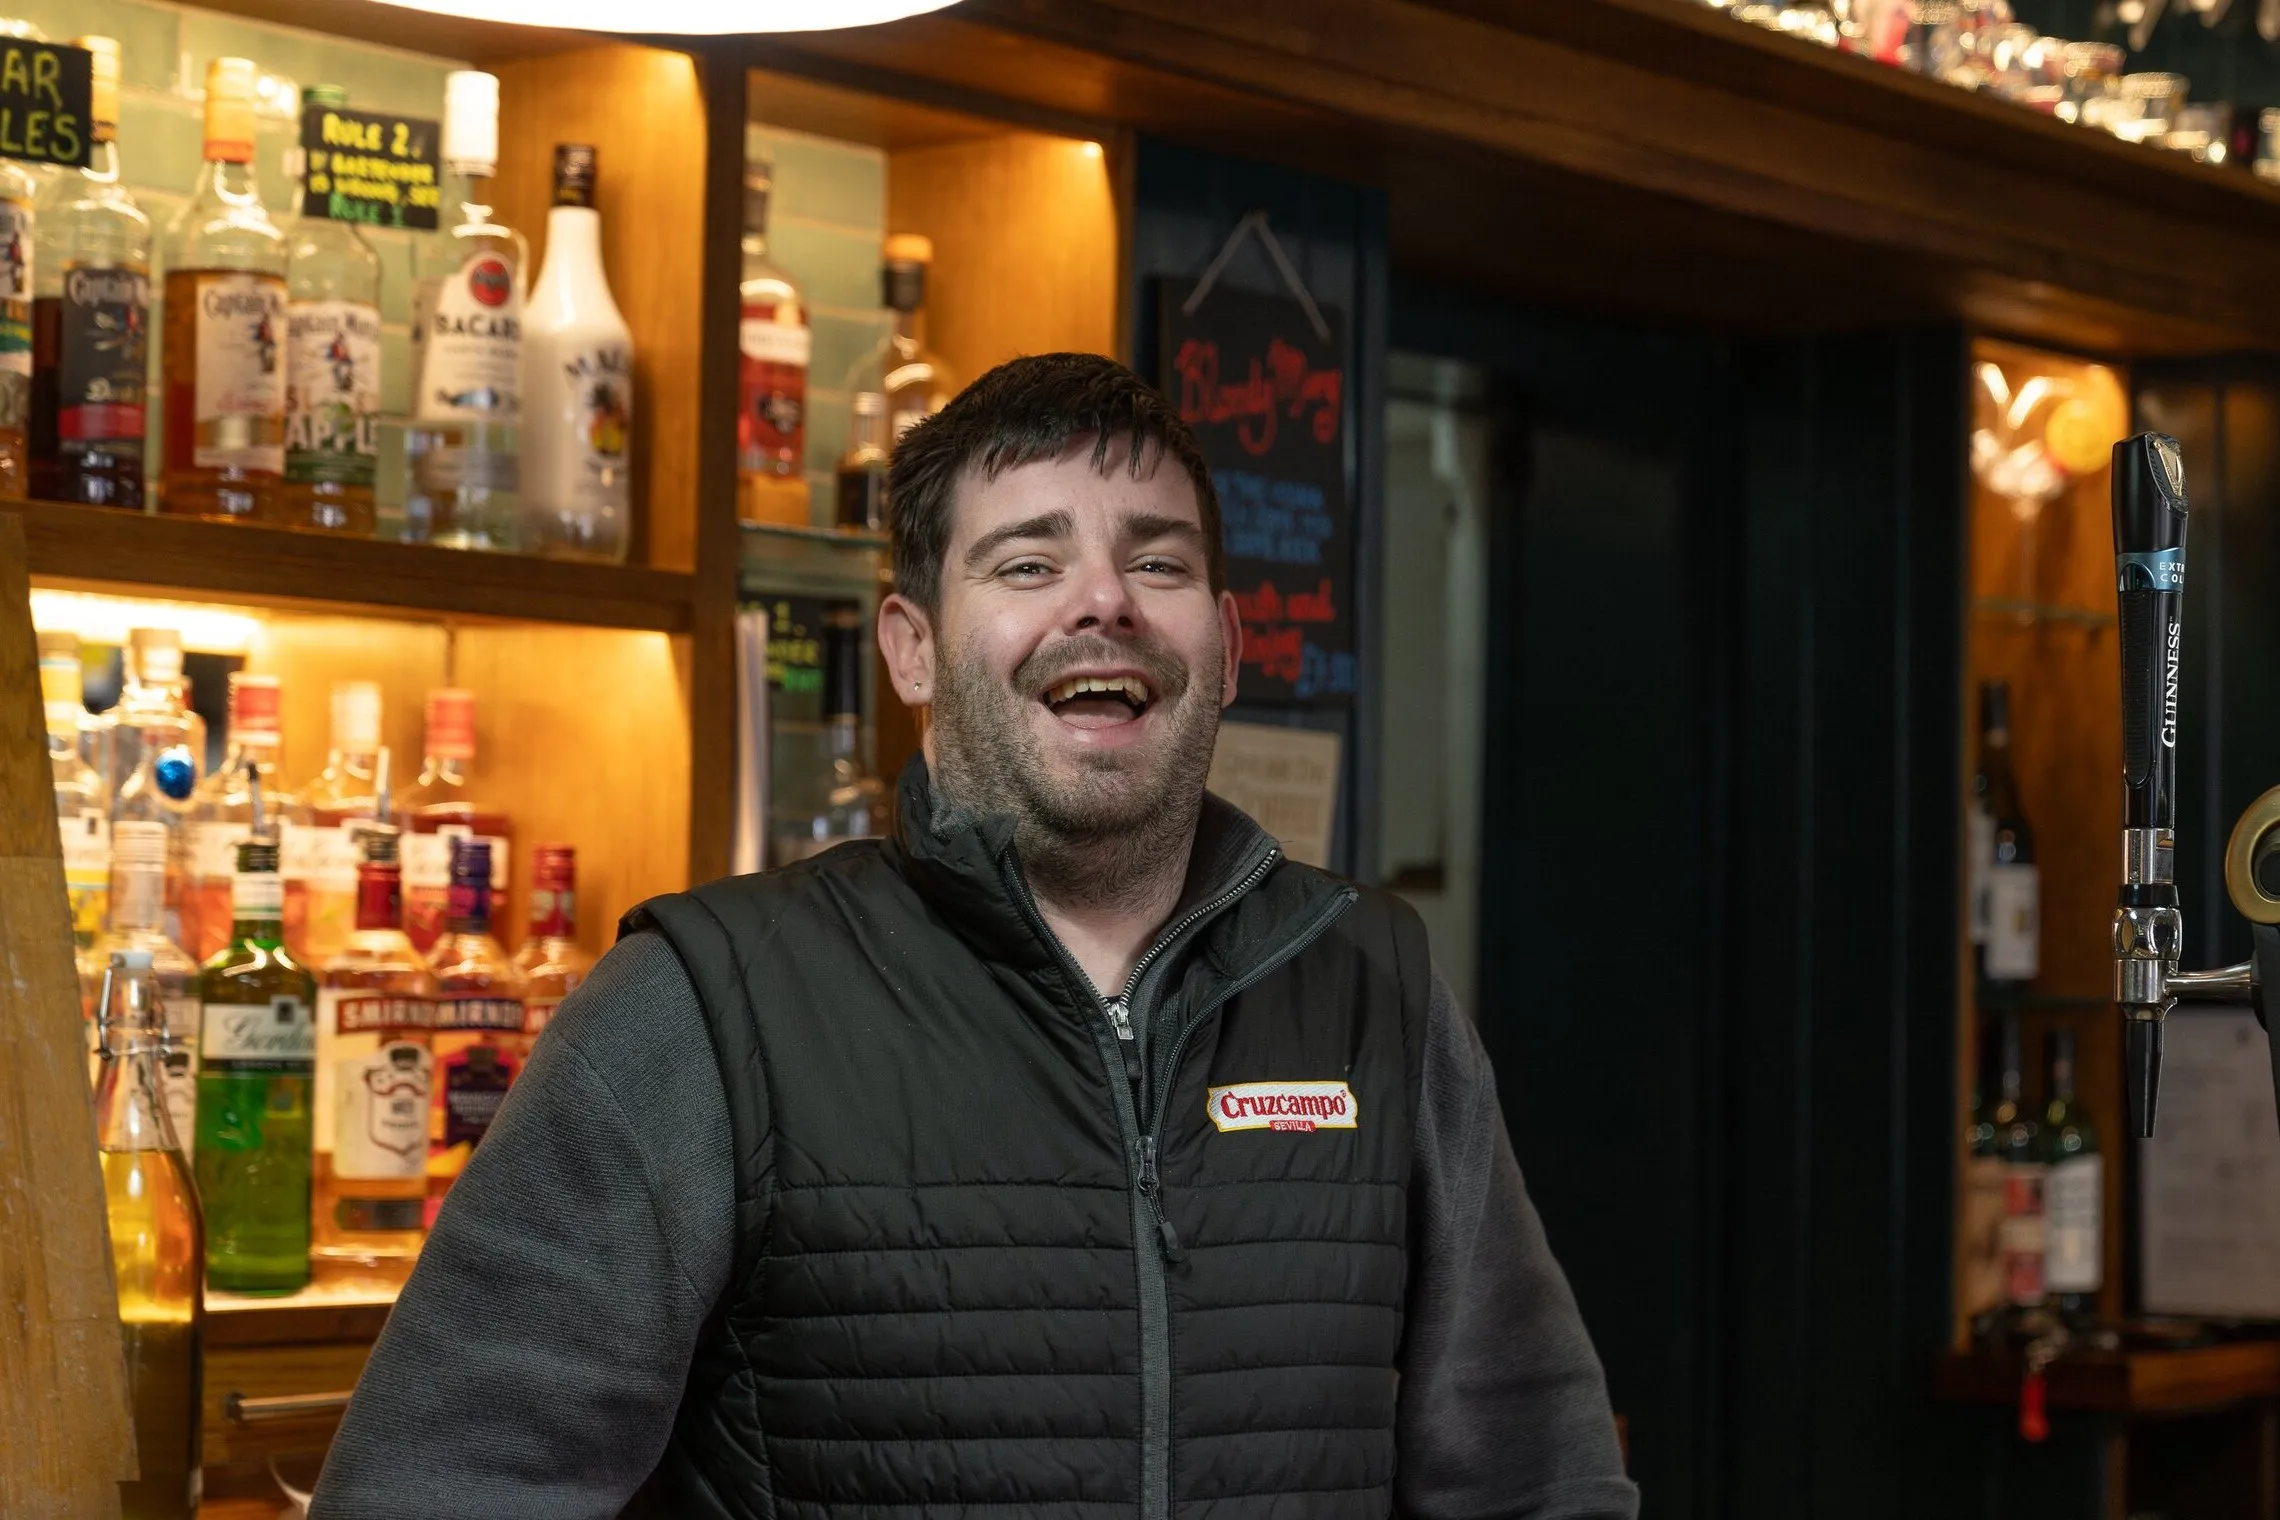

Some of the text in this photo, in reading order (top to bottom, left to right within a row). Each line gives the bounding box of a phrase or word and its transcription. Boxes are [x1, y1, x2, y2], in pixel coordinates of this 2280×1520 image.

[322, 112, 383, 151] RULE
[2161, 622, 2181, 748] GUINNESS
[1220, 1091, 1347, 1120] Cruzcampo
[1273, 1120, 1313, 1133] SEVILLA
